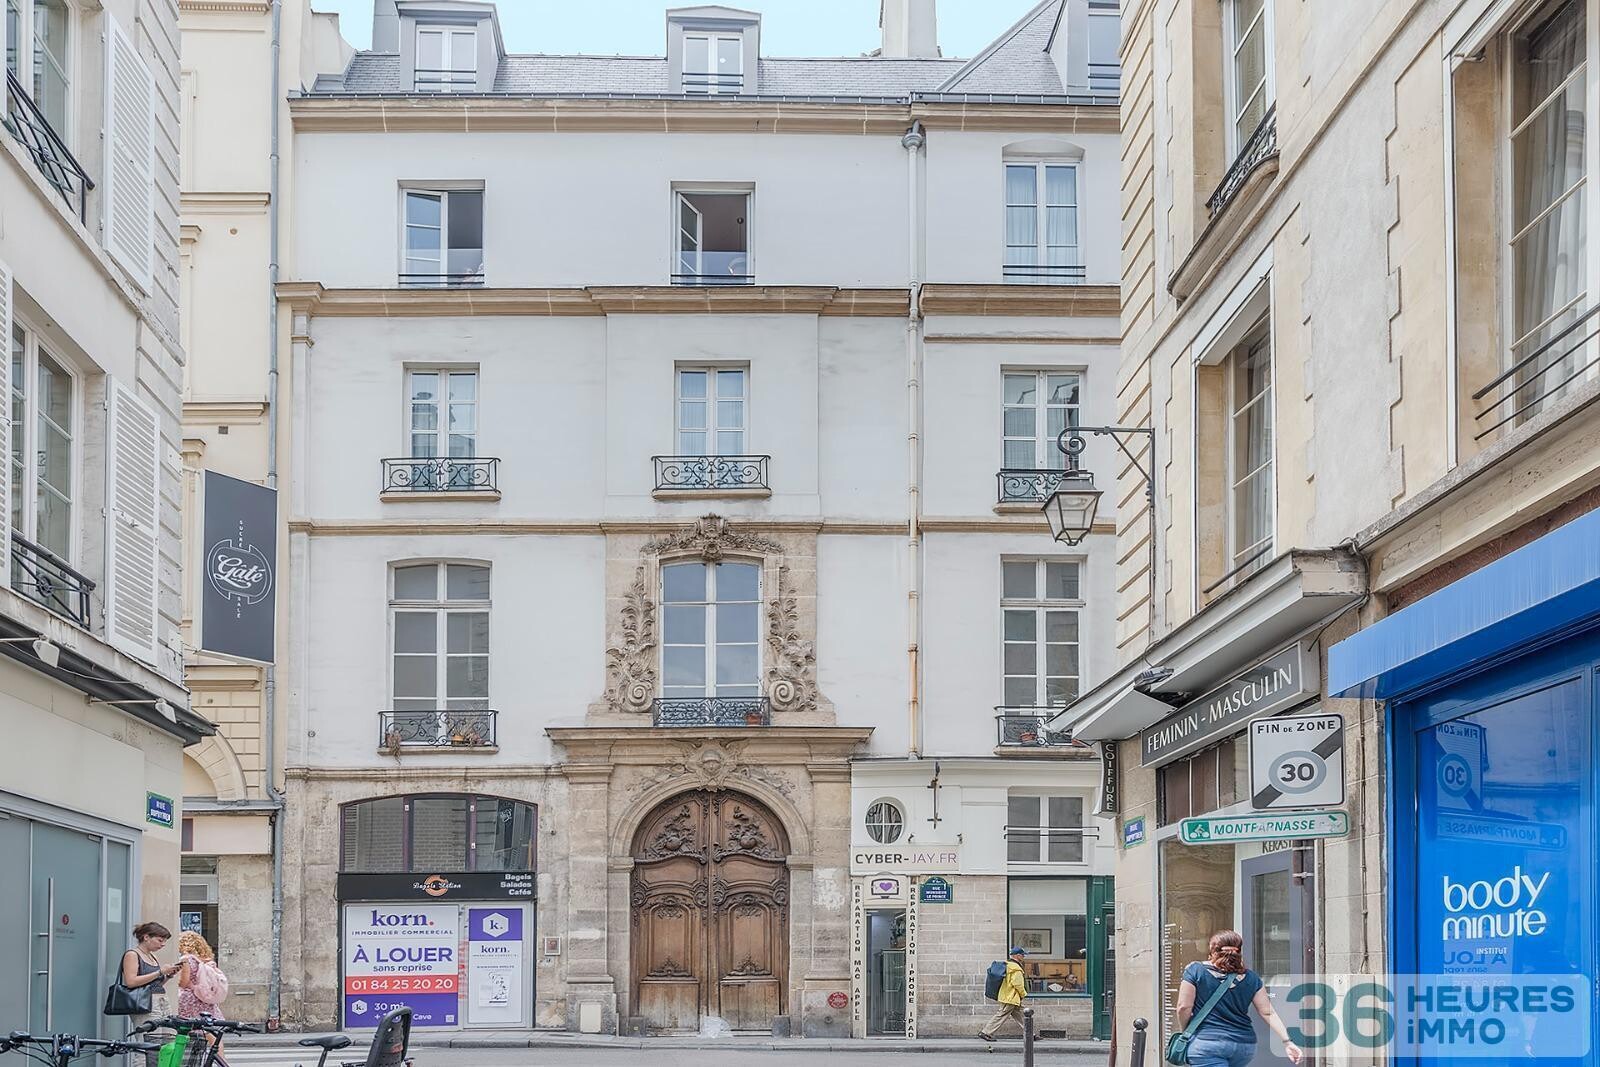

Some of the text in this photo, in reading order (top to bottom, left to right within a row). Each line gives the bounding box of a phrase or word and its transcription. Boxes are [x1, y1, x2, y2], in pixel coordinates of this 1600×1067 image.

[1147, 712, 1199, 754] FEMININ
[1208, 663, 1293, 724] MASCULIN
[1257, 723, 1280, 734] FIN
[1296, 720, 1336, 732] ZONE
[1104, 743, 1115, 811] COIFFURE
[1280, 763, 1315, 782] 30
[504, 873, 532, 881] Bagels
[1443, 866, 1551, 912] body
[370, 909, 435, 927] korn.
[1442, 908, 1547, 941] minute
[352, 944, 453, 963] À LOUER
[481, 944, 511, 954] korn.
[1475, 947, 1508, 955] INSTITUT
[373, 963, 433, 973] sans reprise
[854, 960, 862, 979] MAC
[351, 978, 453, 991] 01 84 25 20 20
[374, 1002, 388, 1011] 30
[412, 1013, 432, 1021] Cave
